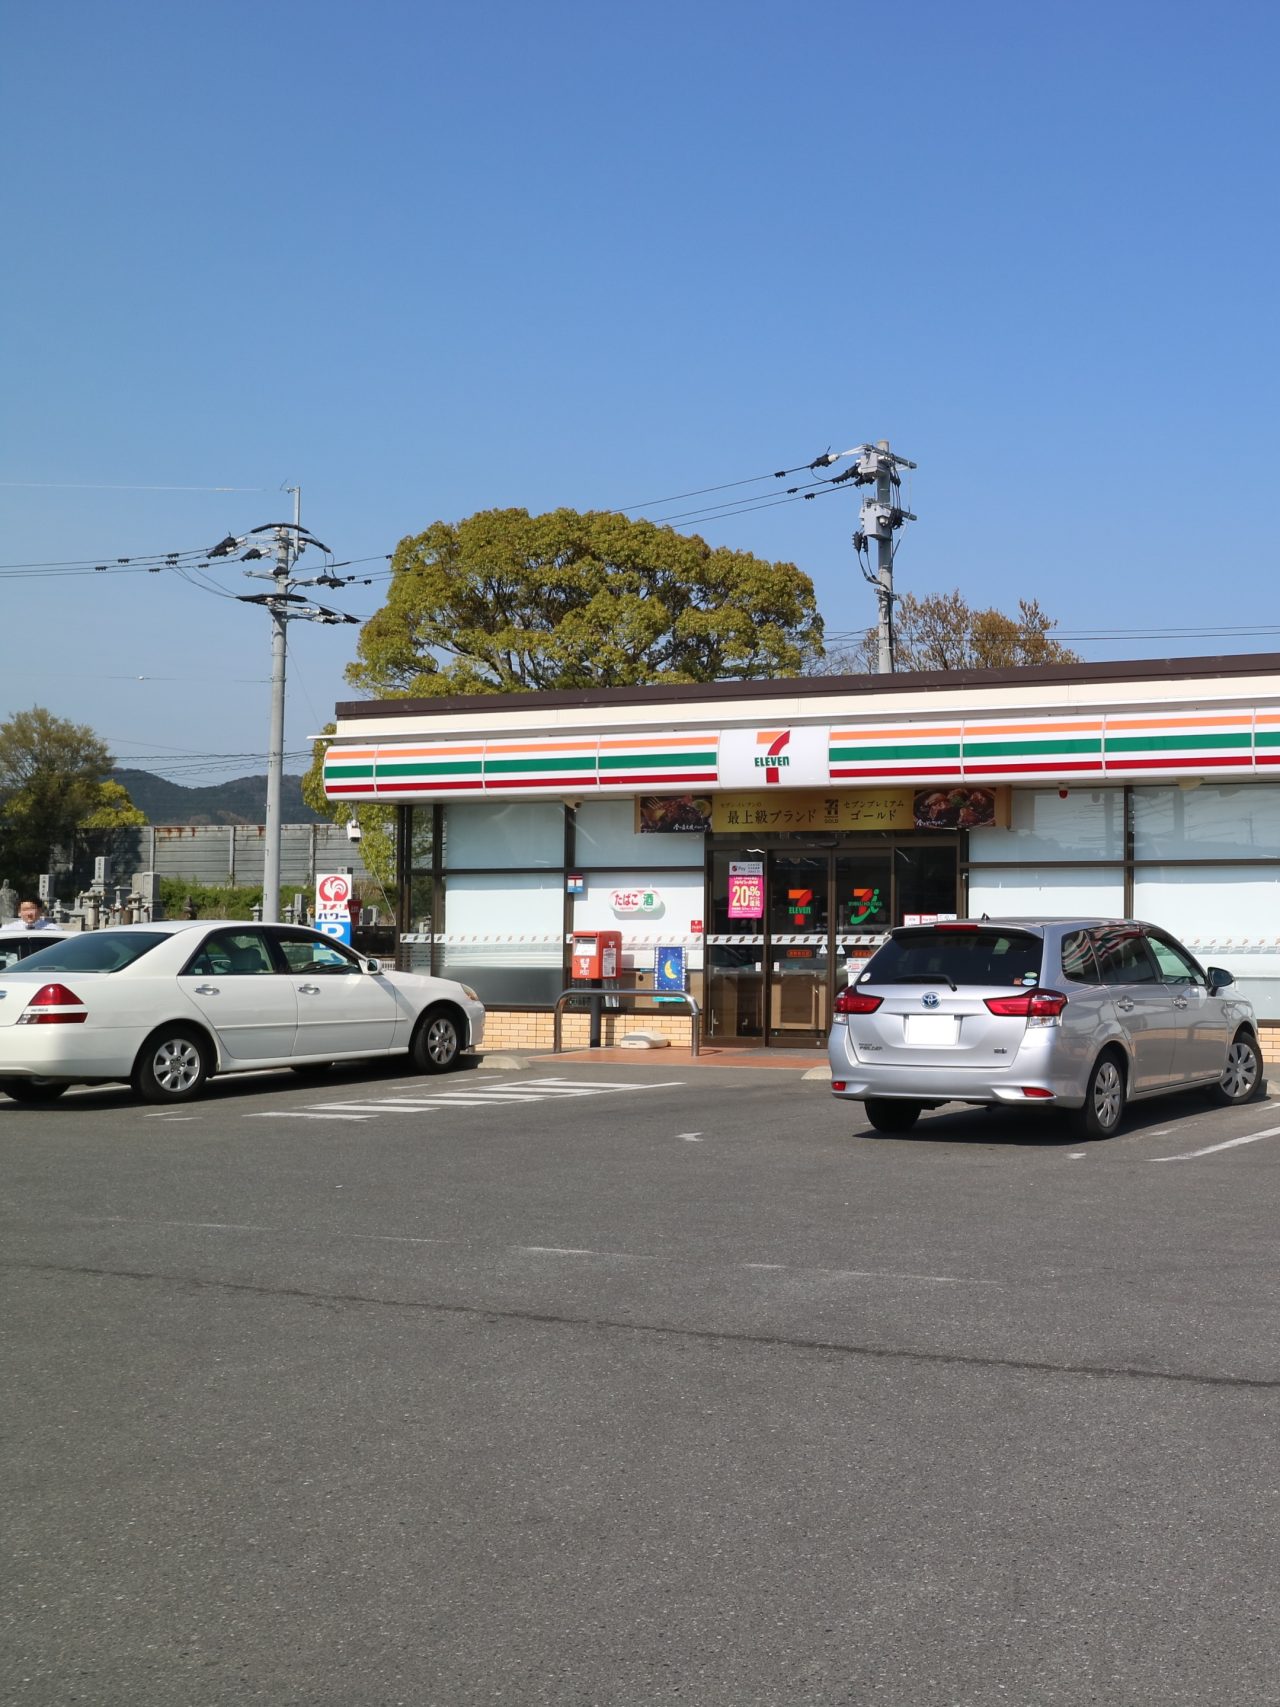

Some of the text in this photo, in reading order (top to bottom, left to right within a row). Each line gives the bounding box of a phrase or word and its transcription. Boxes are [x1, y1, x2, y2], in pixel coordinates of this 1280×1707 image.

[756, 729, 790, 784] 7
[843, 800, 904, 809] セブンプレミアム
[727, 808, 817, 825] 最上級ブランド
[850, 810, 897, 821] ゴールド
[614, 893, 654, 906] たばこ 酒
[788, 889, 813, 926] 7
[318, 912, 349, 920] パワー
